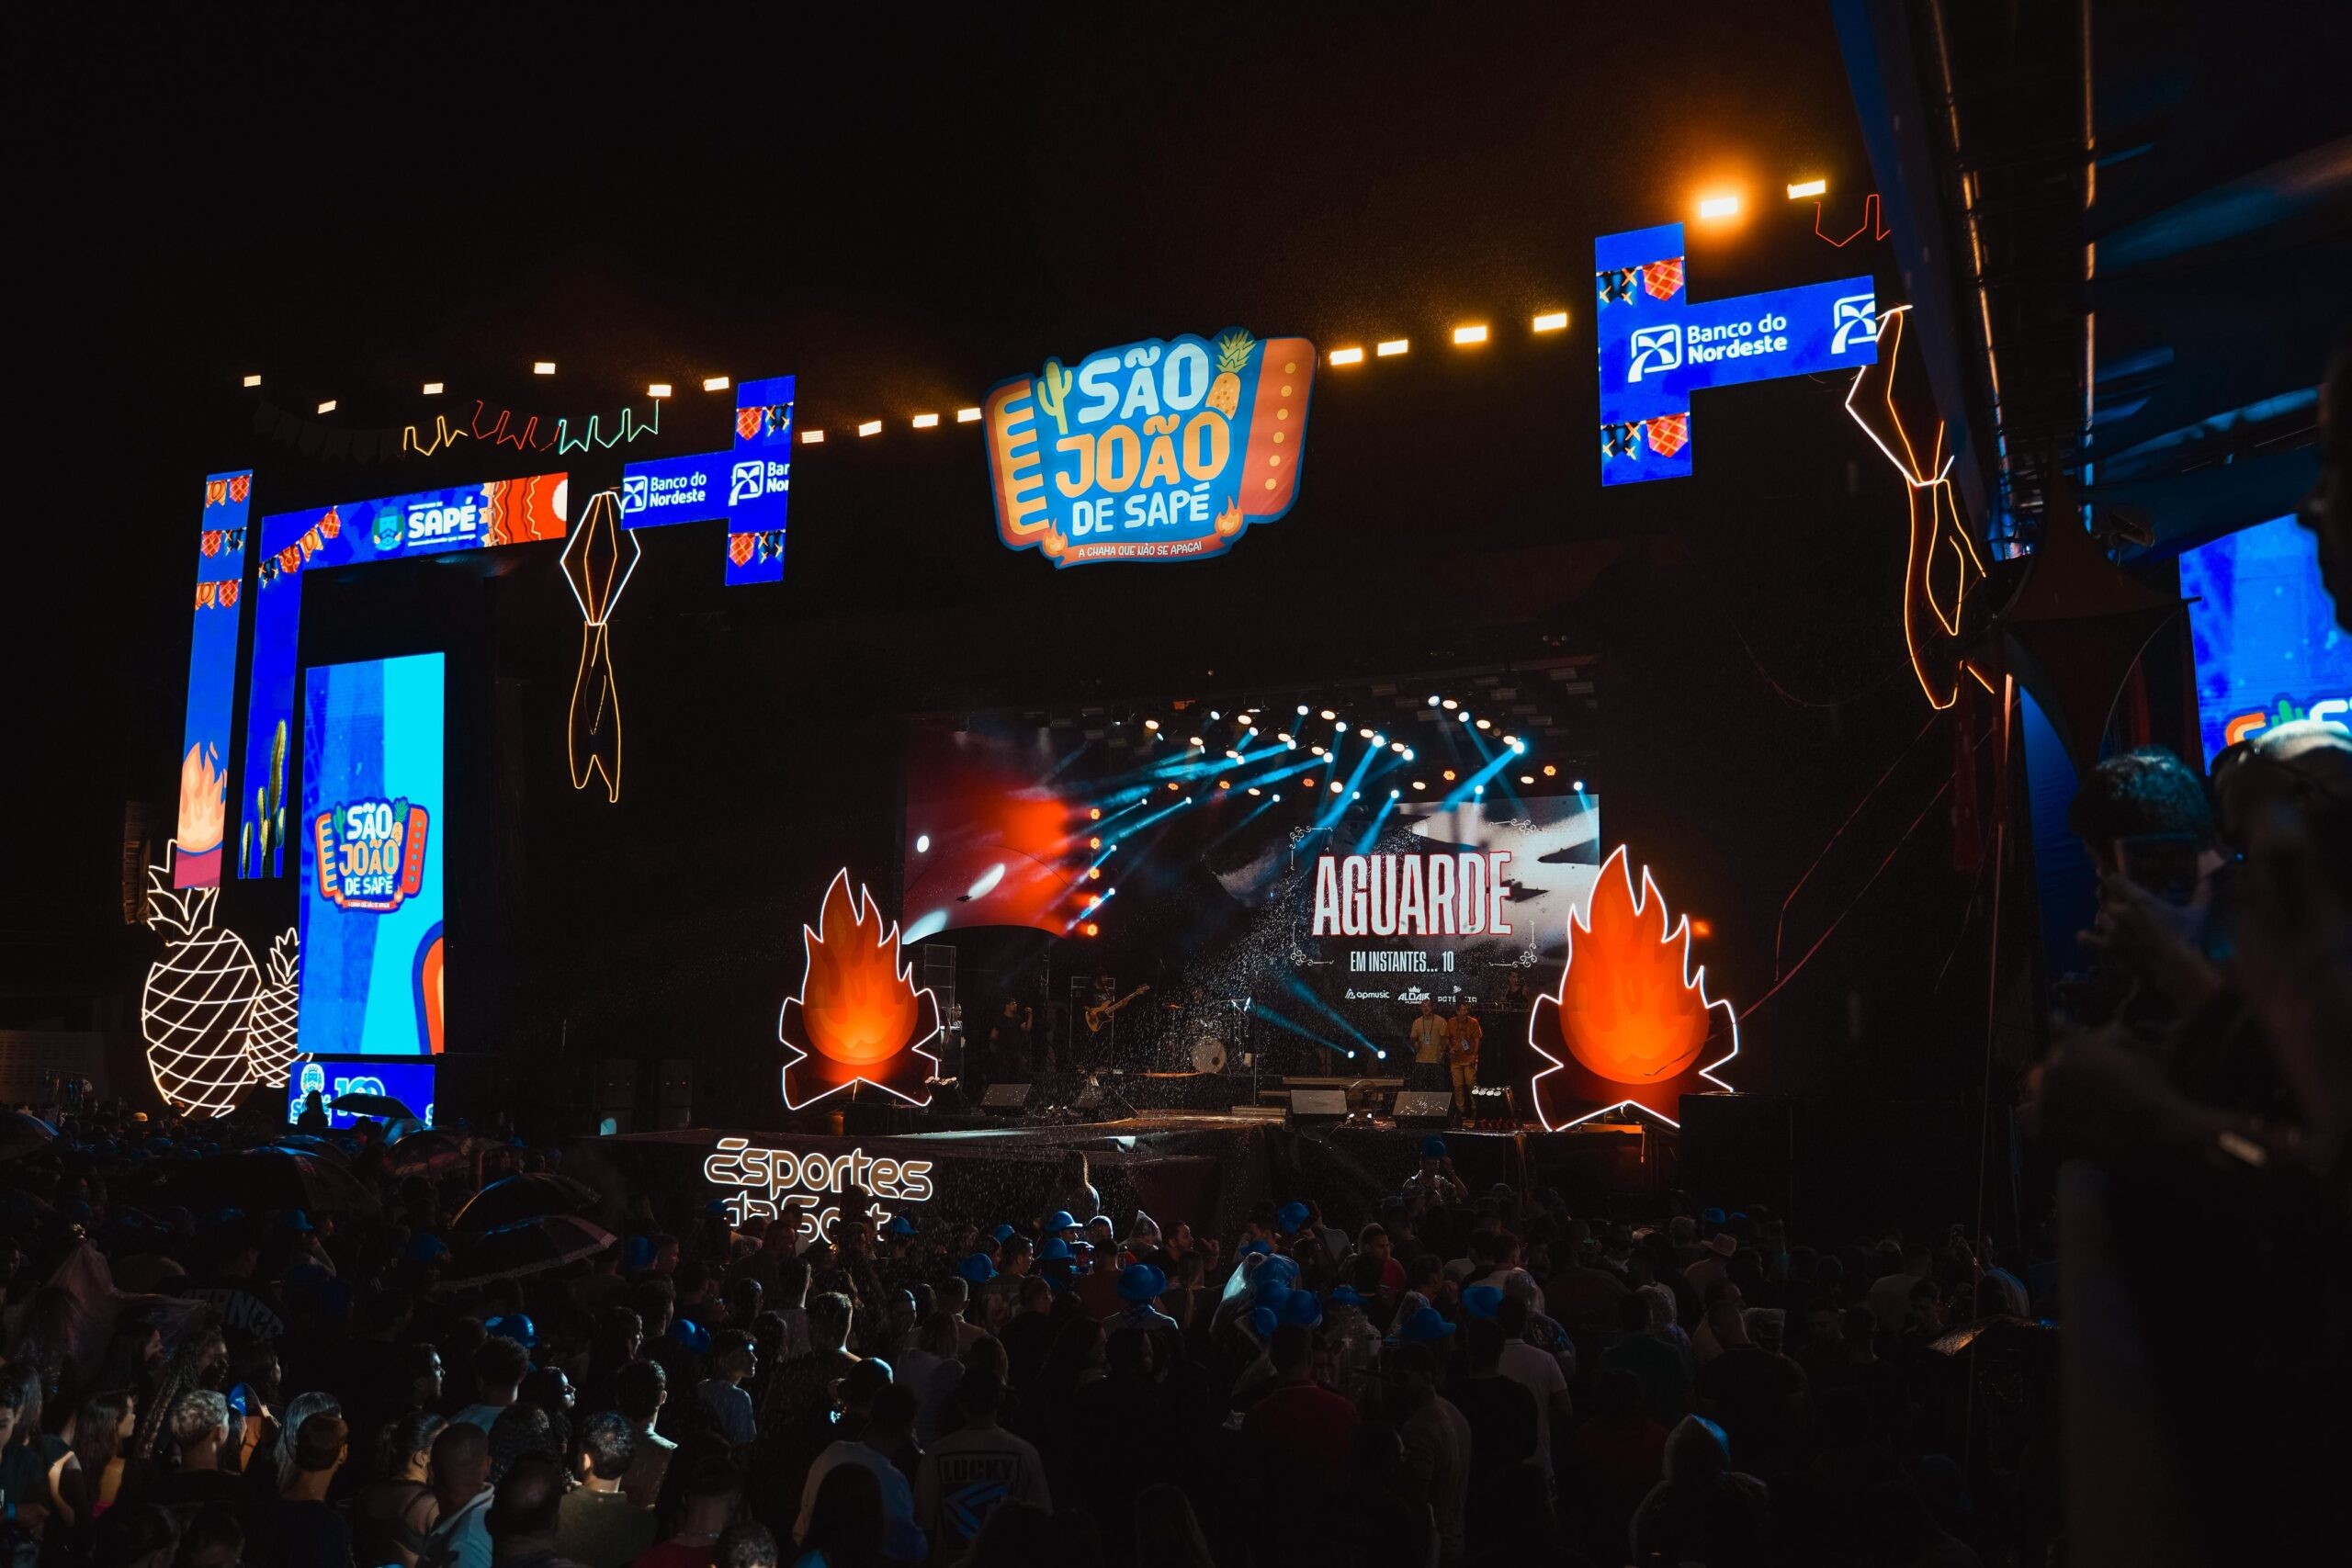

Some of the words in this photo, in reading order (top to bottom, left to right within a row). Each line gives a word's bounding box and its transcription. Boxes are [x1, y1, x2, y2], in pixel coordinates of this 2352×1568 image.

[1687, 321, 1752, 344] Banco
[1758, 313, 1787, 333] do
[1688, 335, 1787, 365] Nordeste
[1078, 343, 1209, 424] SÃO
[1056, 412, 1230, 498] JOÃO
[650, 477, 687, 491] Banco
[690, 471, 707, 486] do
[650, 488, 706, 507] Nordeste
[408, 496, 477, 539] SAPÉ
[1072, 497, 1114, 536] DE
[1124, 482, 1210, 529] SAPÉ
[1079, 548, 1084, 558] A
[1118, 546, 1136, 556] QUE
[1158, 545, 1169, 555] SE
[347, 802, 392, 840] SÃO
[339, 838, 399, 875] JOÃO
[345, 877, 361, 896] DE
[362, 875, 393, 895] SAPÉ
[1312, 851, 1512, 936] AGUARDE
[1350, 952, 1366, 972] EM
[1368, 952, 1439, 972] INSTANTES...
[1442, 952, 1454, 972] 10
[1356, 989, 1391, 1000] apmusic
[704, 1137, 933, 1201] Esportes
